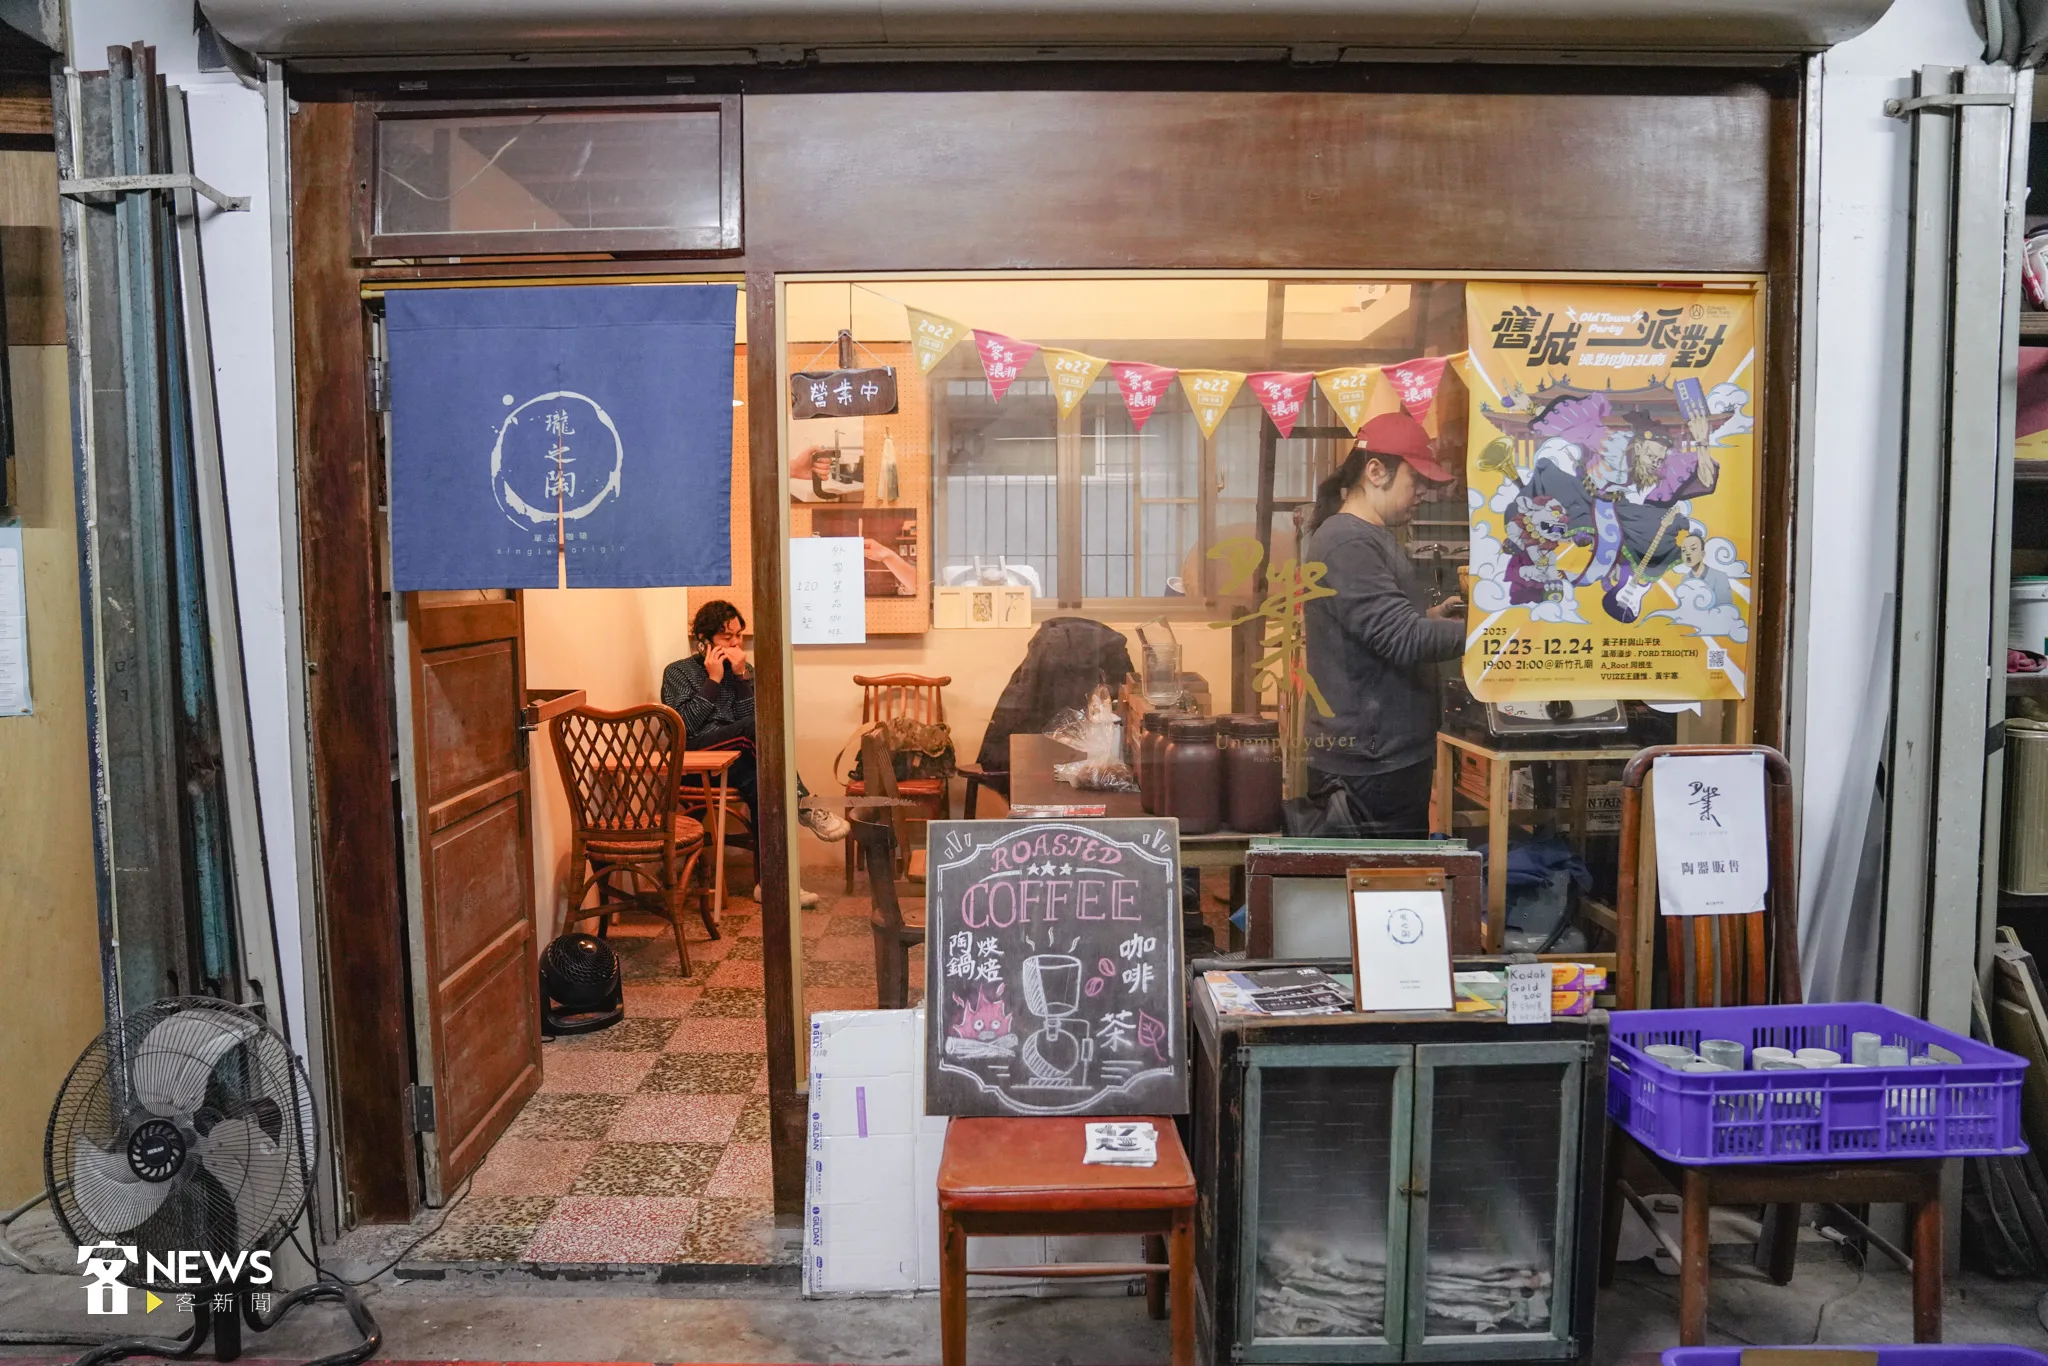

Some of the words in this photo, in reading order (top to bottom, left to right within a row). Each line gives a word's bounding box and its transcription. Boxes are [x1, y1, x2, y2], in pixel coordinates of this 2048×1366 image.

[1579, 312, 1599, 322] Old
[1600, 312, 1632, 323] Town
[918, 320, 953, 339] 2022
[1588, 324, 1624, 335] Party
[1055, 357, 1091, 375] 2022
[1193, 378, 1229, 392] 2022
[1333, 373, 1368, 390] 2022
[810, 378, 879, 408] 營業中
[497, 548, 552, 557] single
[572, 545, 626, 554] origin
[796, 581, 819, 592] 120
[1661, 649, 1699, 658] TRIO(TH)
[1216, 732, 1357, 752] Unempoydyer
[990, 833, 1123, 872] ROASTED
[1681, 860, 1740, 876] 陶器販售
[962, 879, 1142, 929] COFFEE
[946, 931, 976, 981] 陶鍋
[975, 936, 1004, 982] 烘焙
[1119, 932, 1157, 994] 咖啡
[1510, 969, 1547, 980] Kodak
[1510, 982, 1539, 992] Gold
[1096, 1009, 1137, 1052] 茶
[812, 1121, 820, 1150] GILDAN
[812, 1216, 820, 1245] GILDAN
